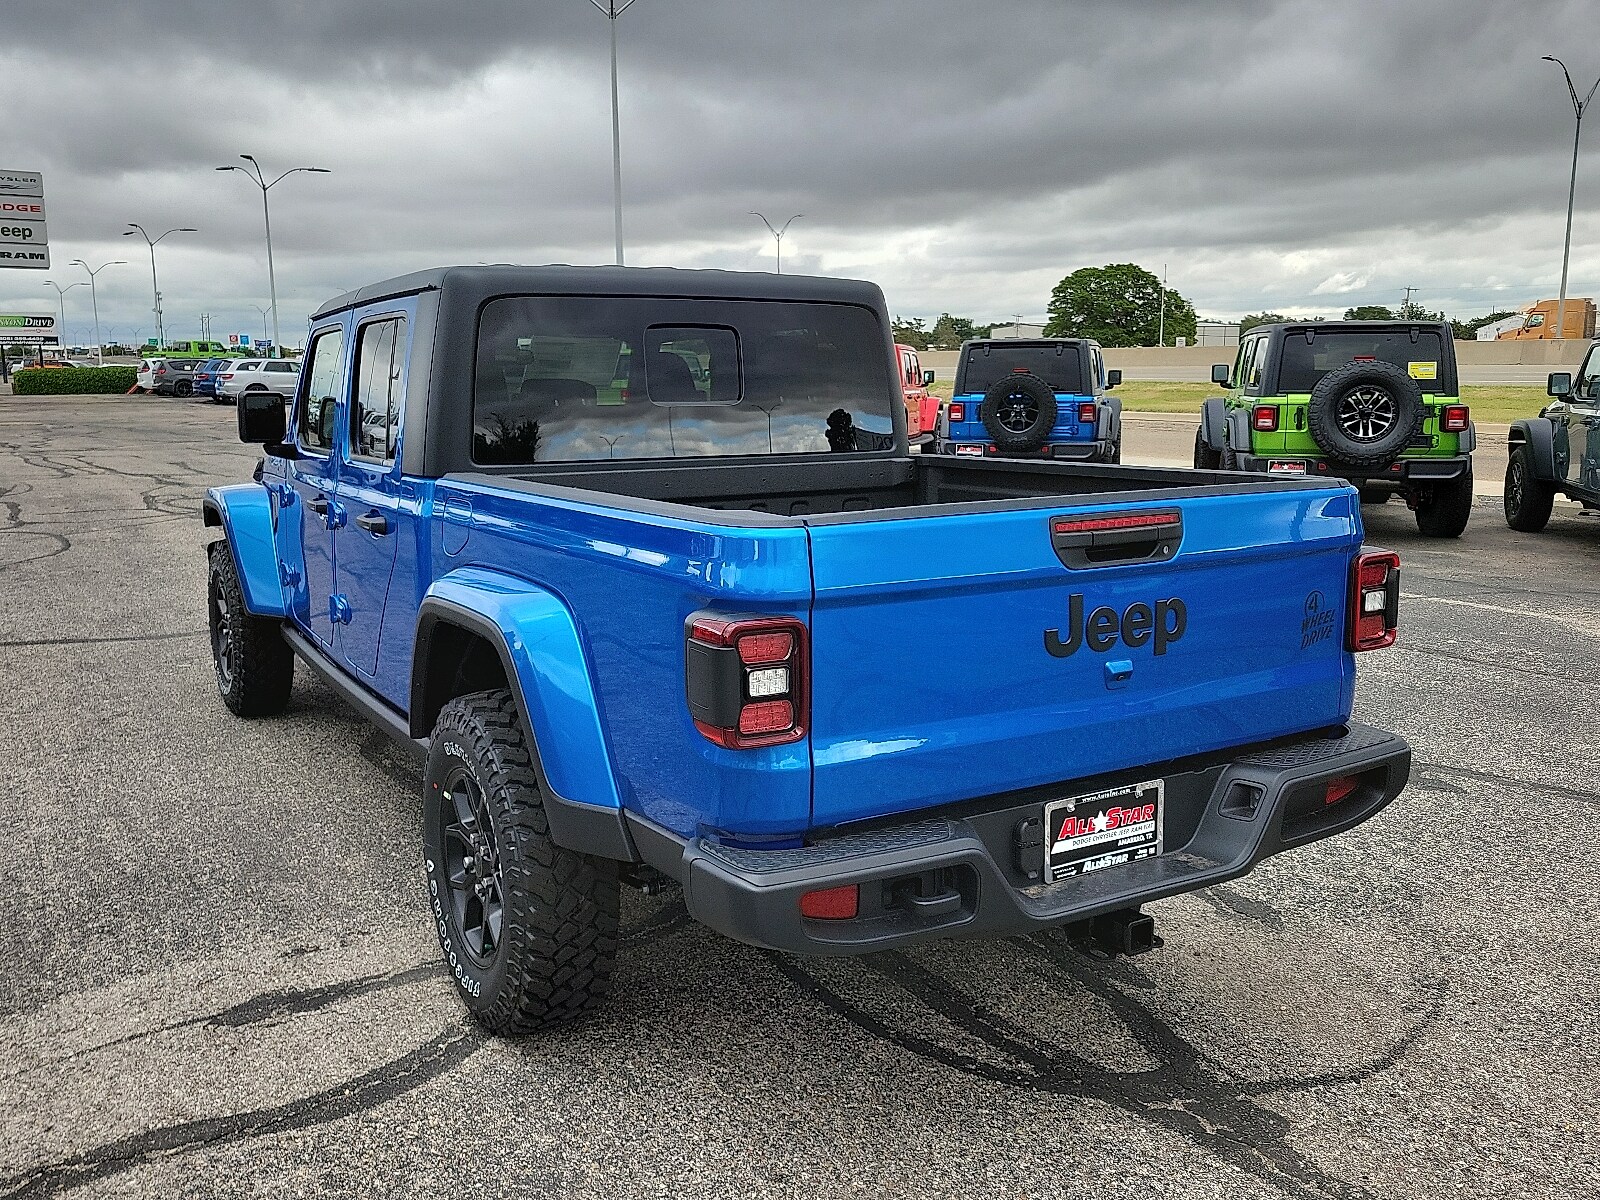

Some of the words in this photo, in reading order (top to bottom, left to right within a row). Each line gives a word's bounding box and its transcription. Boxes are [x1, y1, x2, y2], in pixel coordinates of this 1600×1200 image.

[0, 204, 41, 213] DGE
[0, 251, 46, 260] RAM
[1044, 593, 1188, 658] Jeep
[1301, 609, 1336, 634] WHEEL
[1301, 625, 1334, 650] DRIVE
[1072, 836, 1092, 847] DODGE
